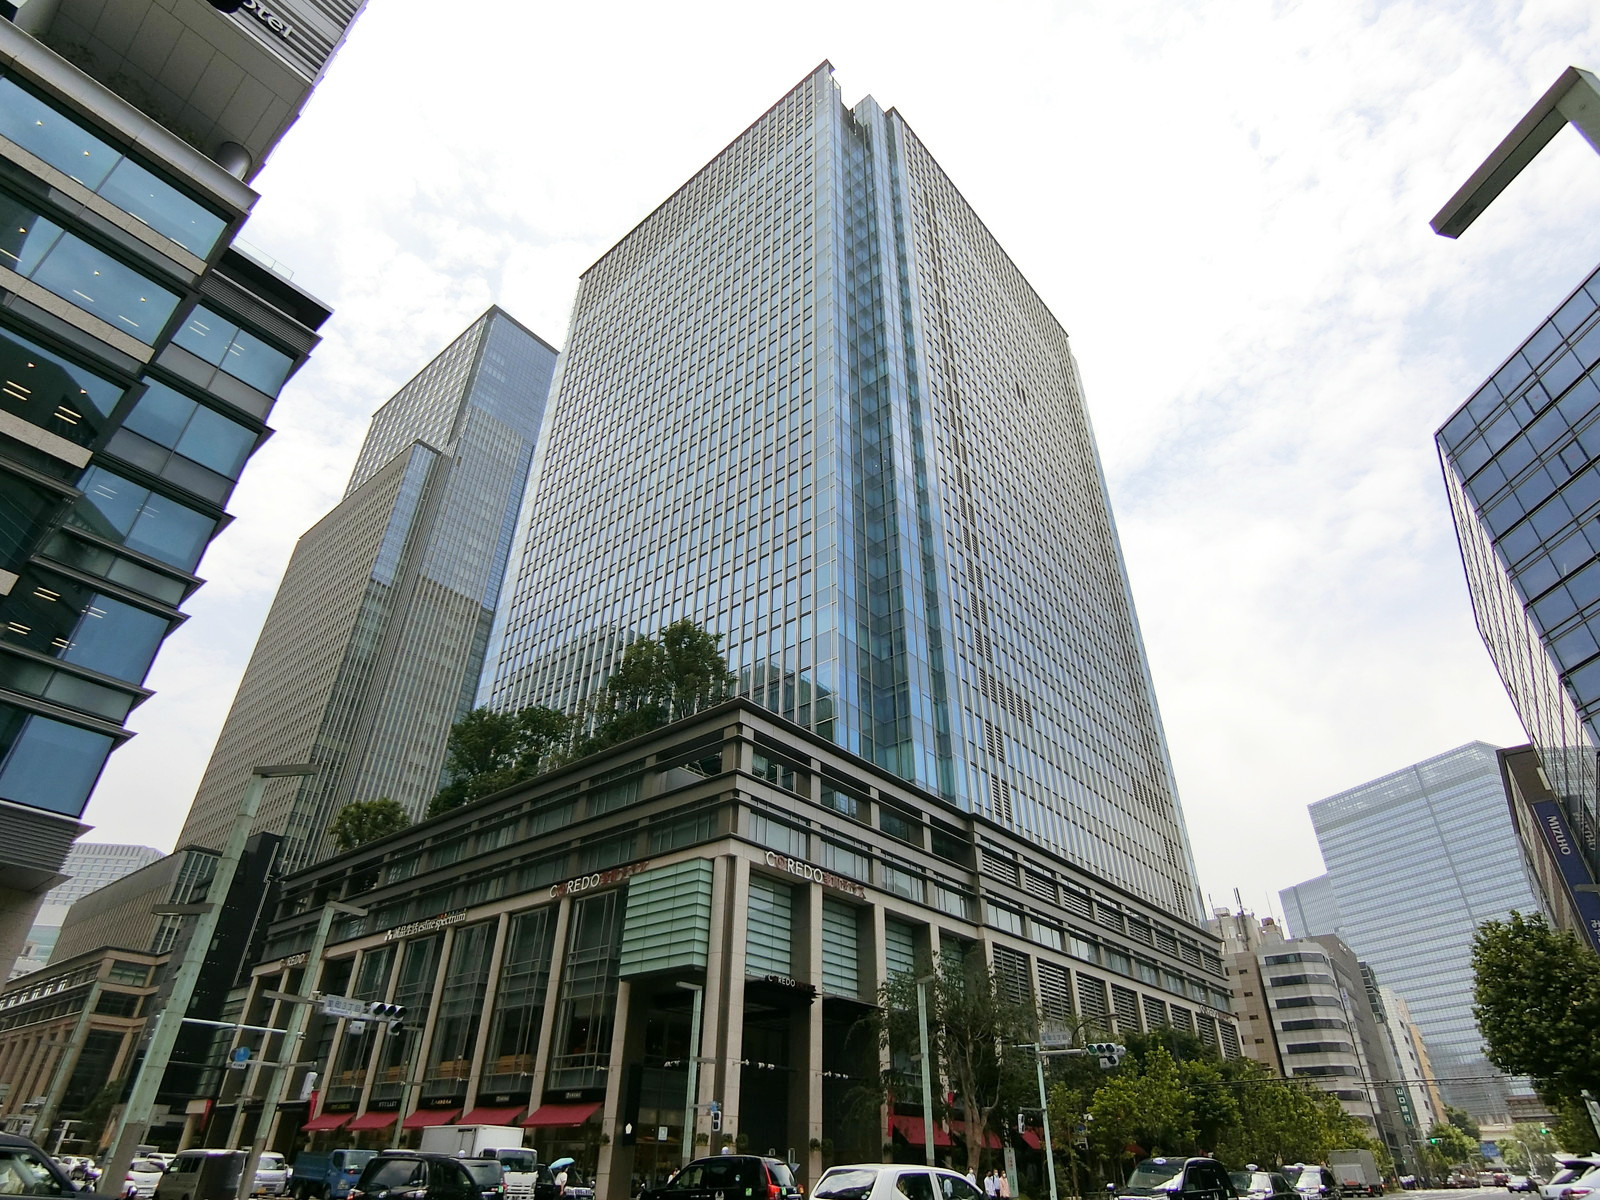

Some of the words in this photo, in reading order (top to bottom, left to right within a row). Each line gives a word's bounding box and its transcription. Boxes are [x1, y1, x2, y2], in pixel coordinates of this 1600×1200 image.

[1546, 815, 1571, 856] MIZUHO
[766, 851, 823, 883] COREDO
[768, 974, 796, 988] CREDO
